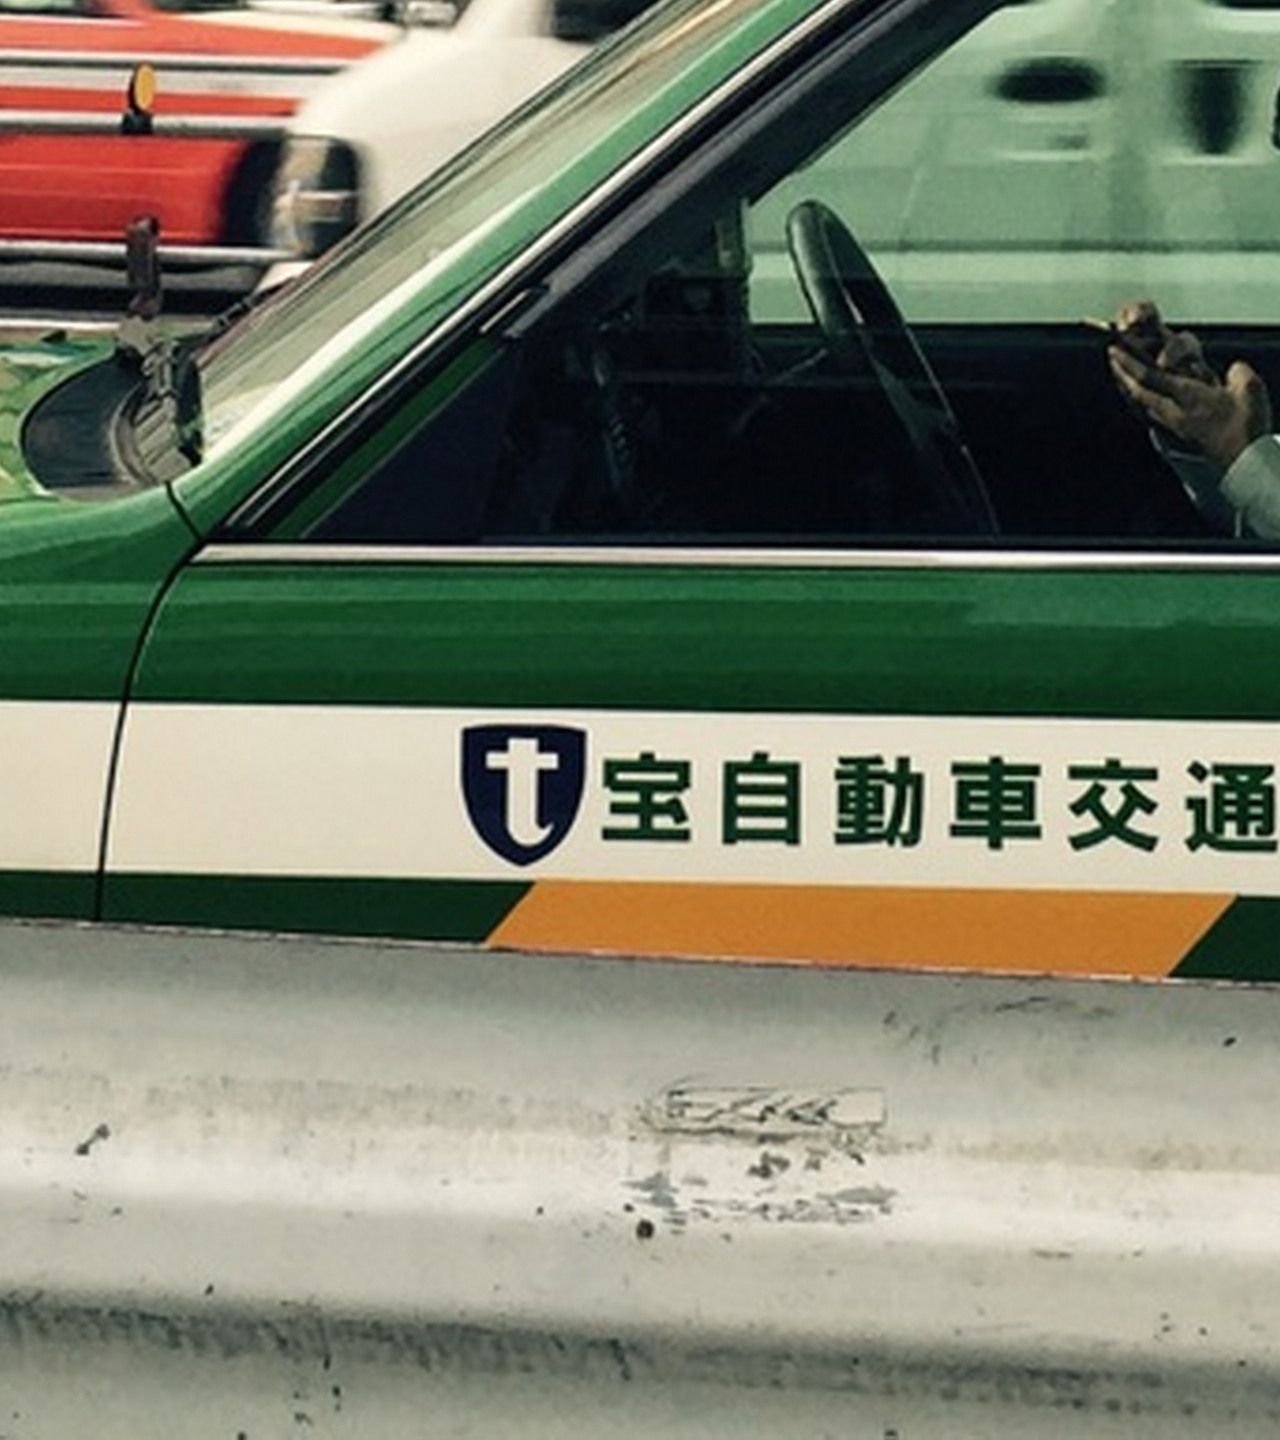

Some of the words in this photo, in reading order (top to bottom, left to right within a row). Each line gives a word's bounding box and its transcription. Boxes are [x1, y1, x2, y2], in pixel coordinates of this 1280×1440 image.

[600, 751, 1280, 854] 宝自動車交通
